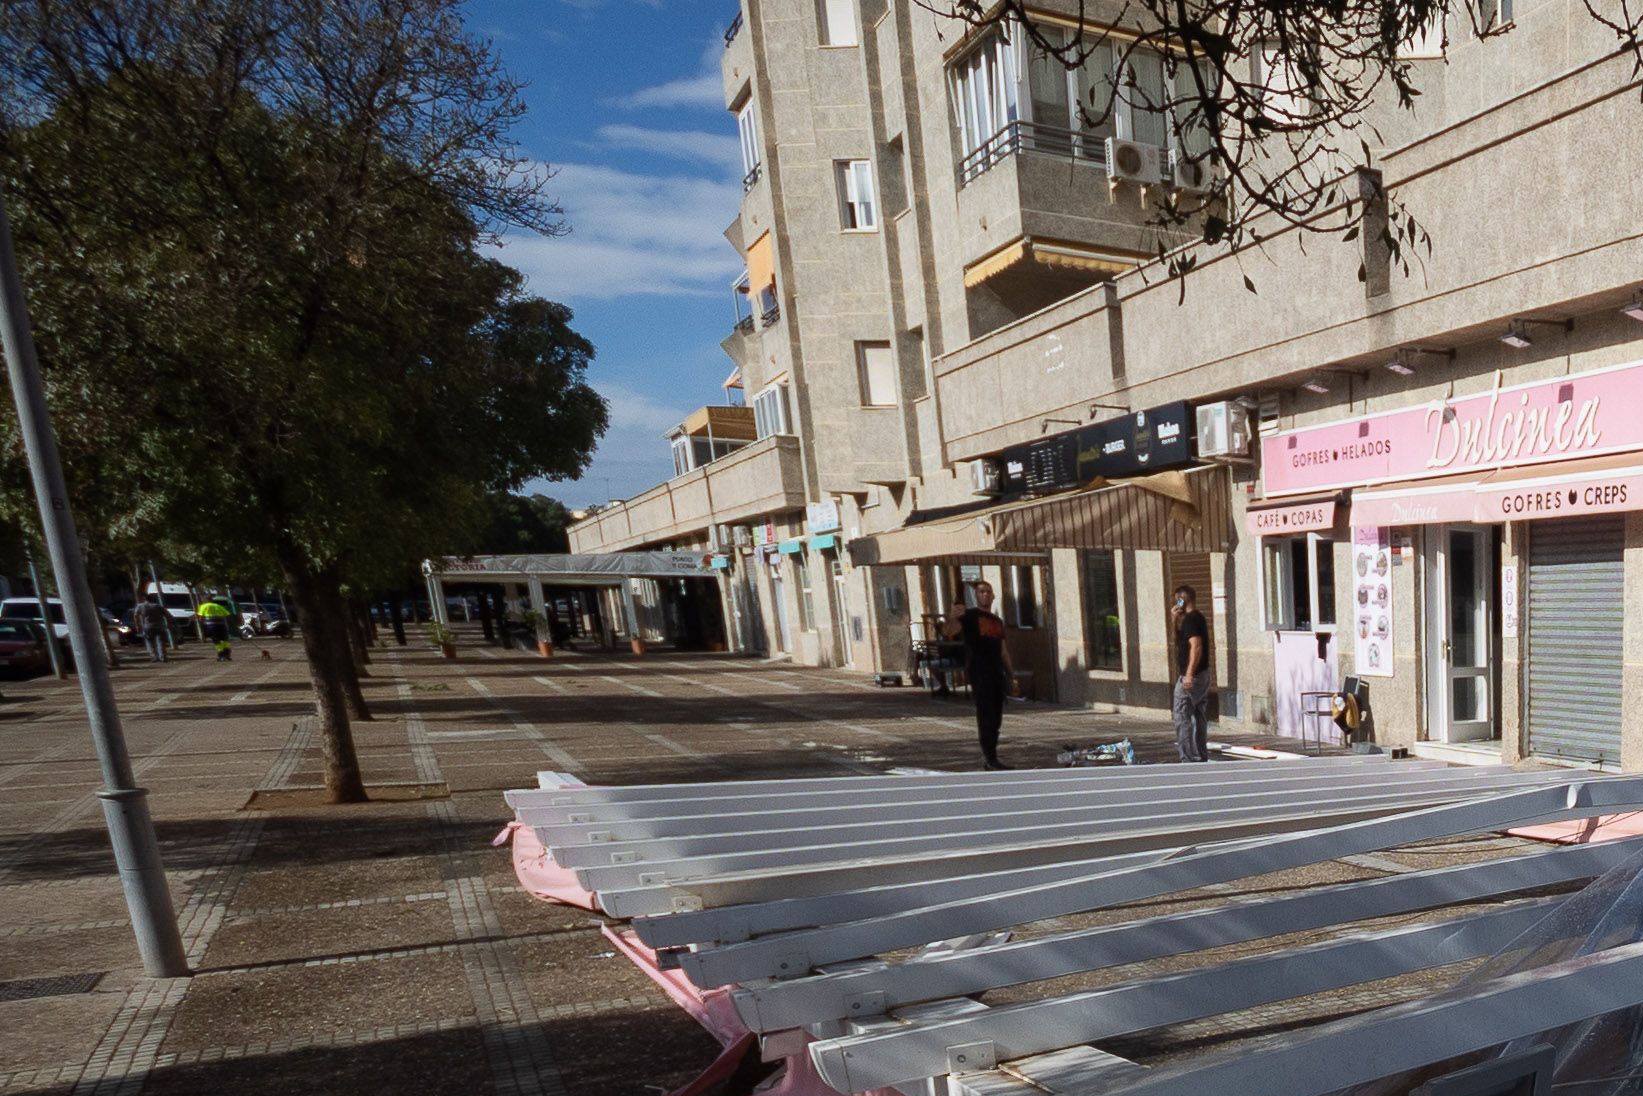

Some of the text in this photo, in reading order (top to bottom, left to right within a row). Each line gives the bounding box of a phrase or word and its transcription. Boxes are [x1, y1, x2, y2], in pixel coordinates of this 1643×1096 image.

[1425, 369, 1602, 469] Dulcinea
[1292, 439, 1392, 468] GOFRES HELADOS
[1502, 484, 1628, 513] GOFRES CREPS
[1257, 509, 1323, 528] CAFÉ COPAS
